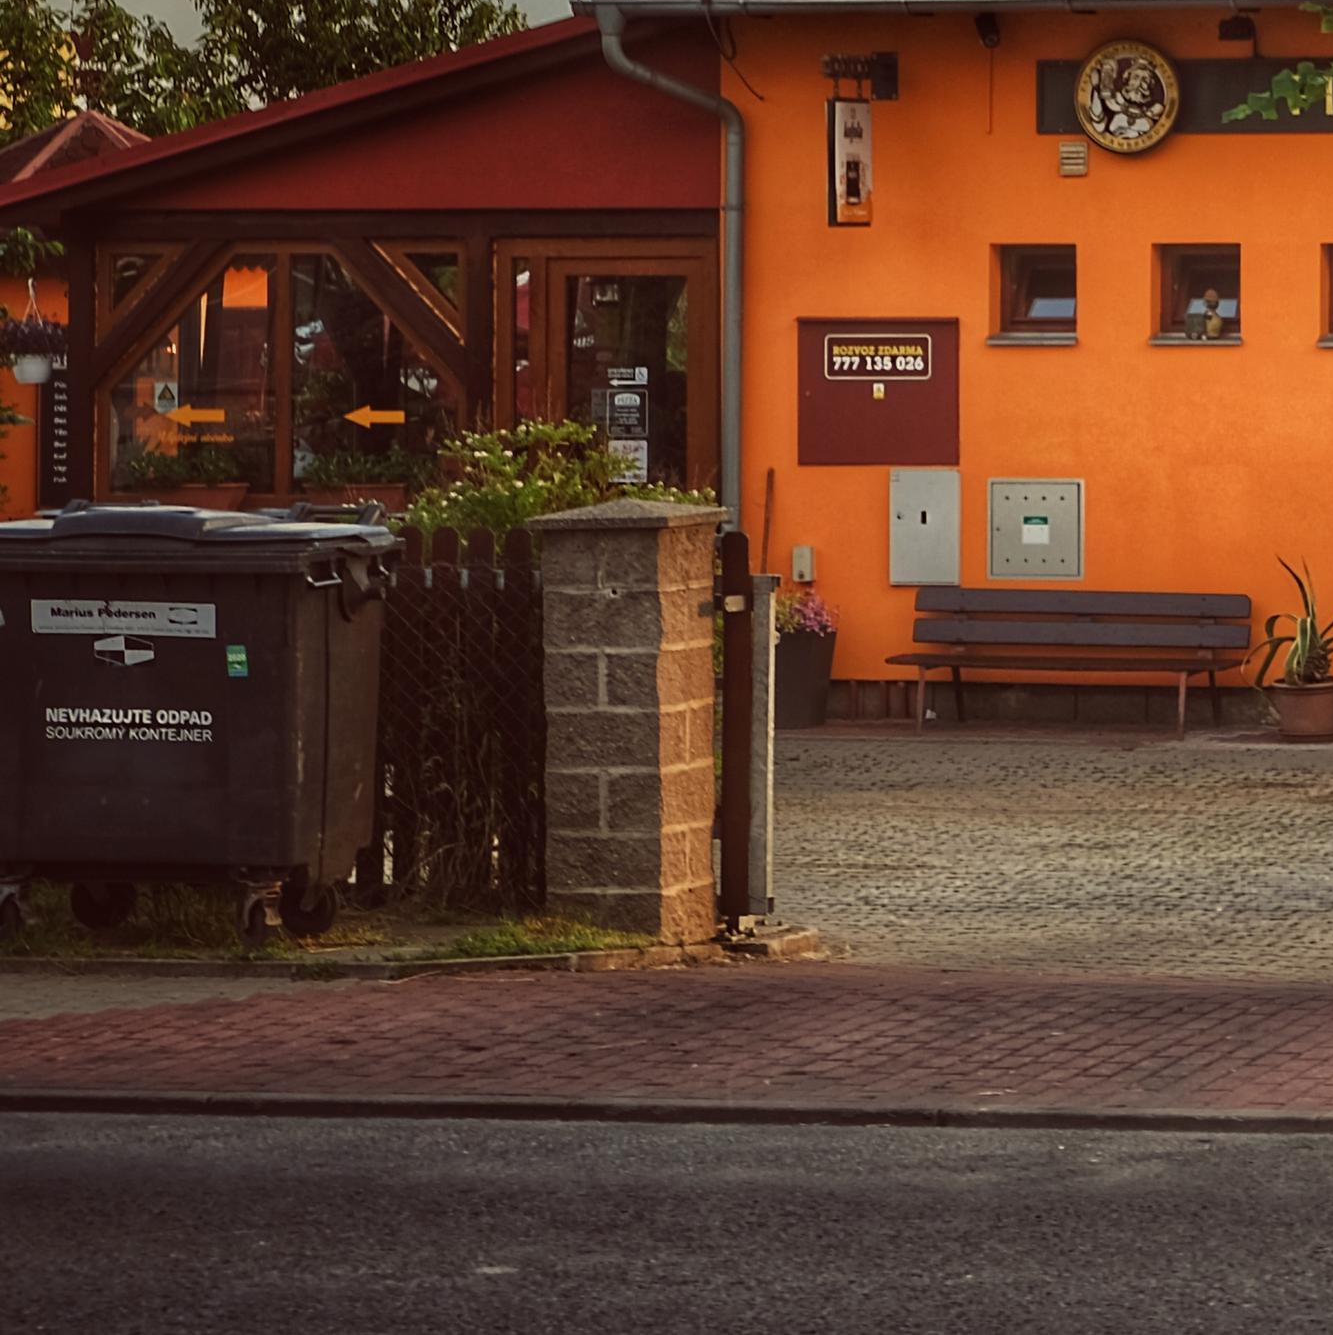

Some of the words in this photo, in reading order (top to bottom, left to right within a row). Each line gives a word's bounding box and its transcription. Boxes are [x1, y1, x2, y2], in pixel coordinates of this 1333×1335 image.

[832, 345, 875, 356] ROZVOZ
[877, 345, 924, 356] ZDARMA
[832, 356, 860, 371] 777
[865, 356, 893, 371] 135
[895, 356, 924, 371] 026
[50, 607, 93, 618] Marius
[98, 607, 156, 619] Pedersen
[45, 707, 152, 724] NEVHAZUJTE
[156, 709, 213, 725] ODPAD
[45, 724, 125, 740] SOUKROMÝ
[128, 726, 213, 742] KONTEJNER
